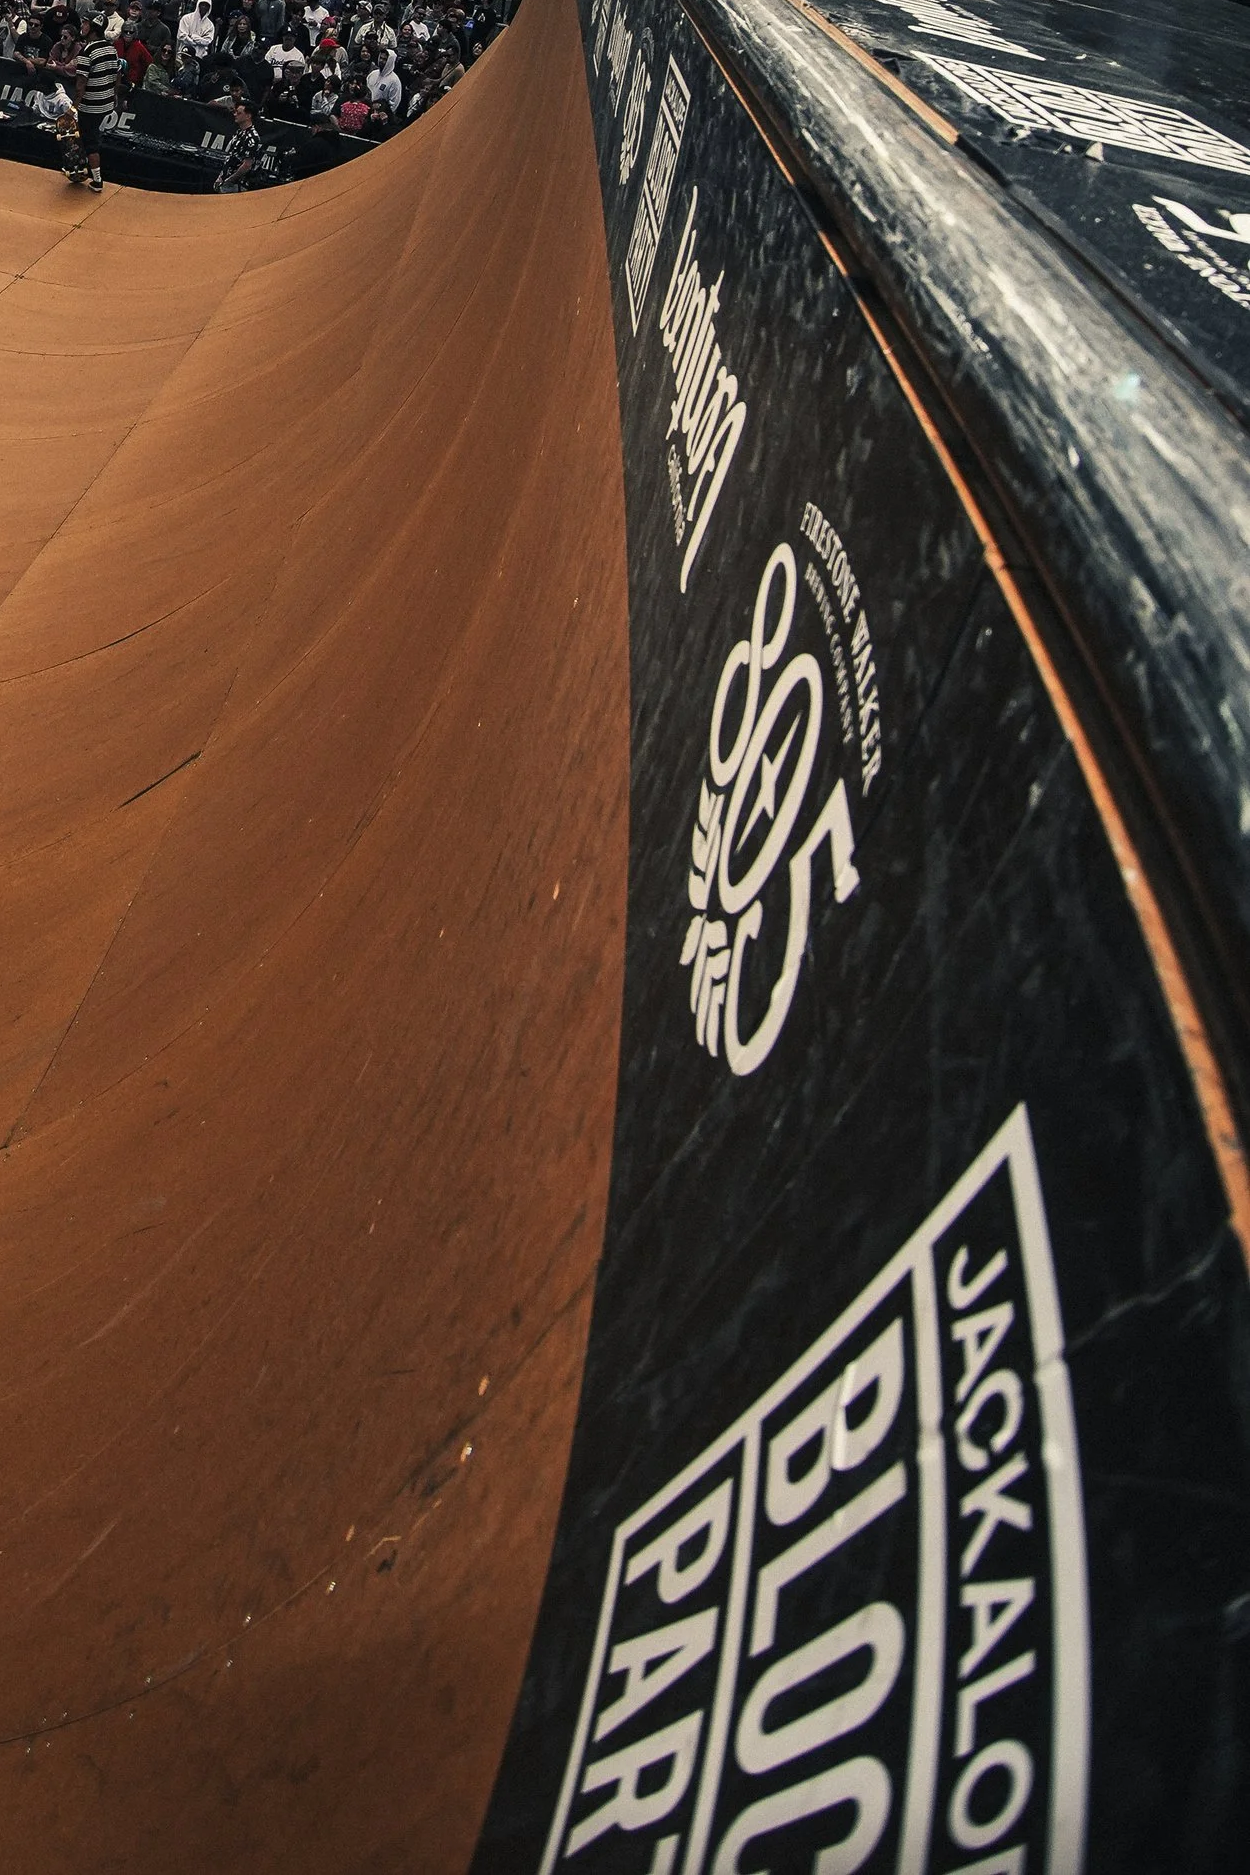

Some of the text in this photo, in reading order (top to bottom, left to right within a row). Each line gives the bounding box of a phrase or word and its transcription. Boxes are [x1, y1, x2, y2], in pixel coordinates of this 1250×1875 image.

[710, 542, 860, 1076] 805
[799, 501, 882, 797] FIRESTONE WALKER
[562, 1477, 734, 1875] PAR
[712, 1317, 907, 1875] BLOC
[947, 1245, 1037, 1875] JACKALO
